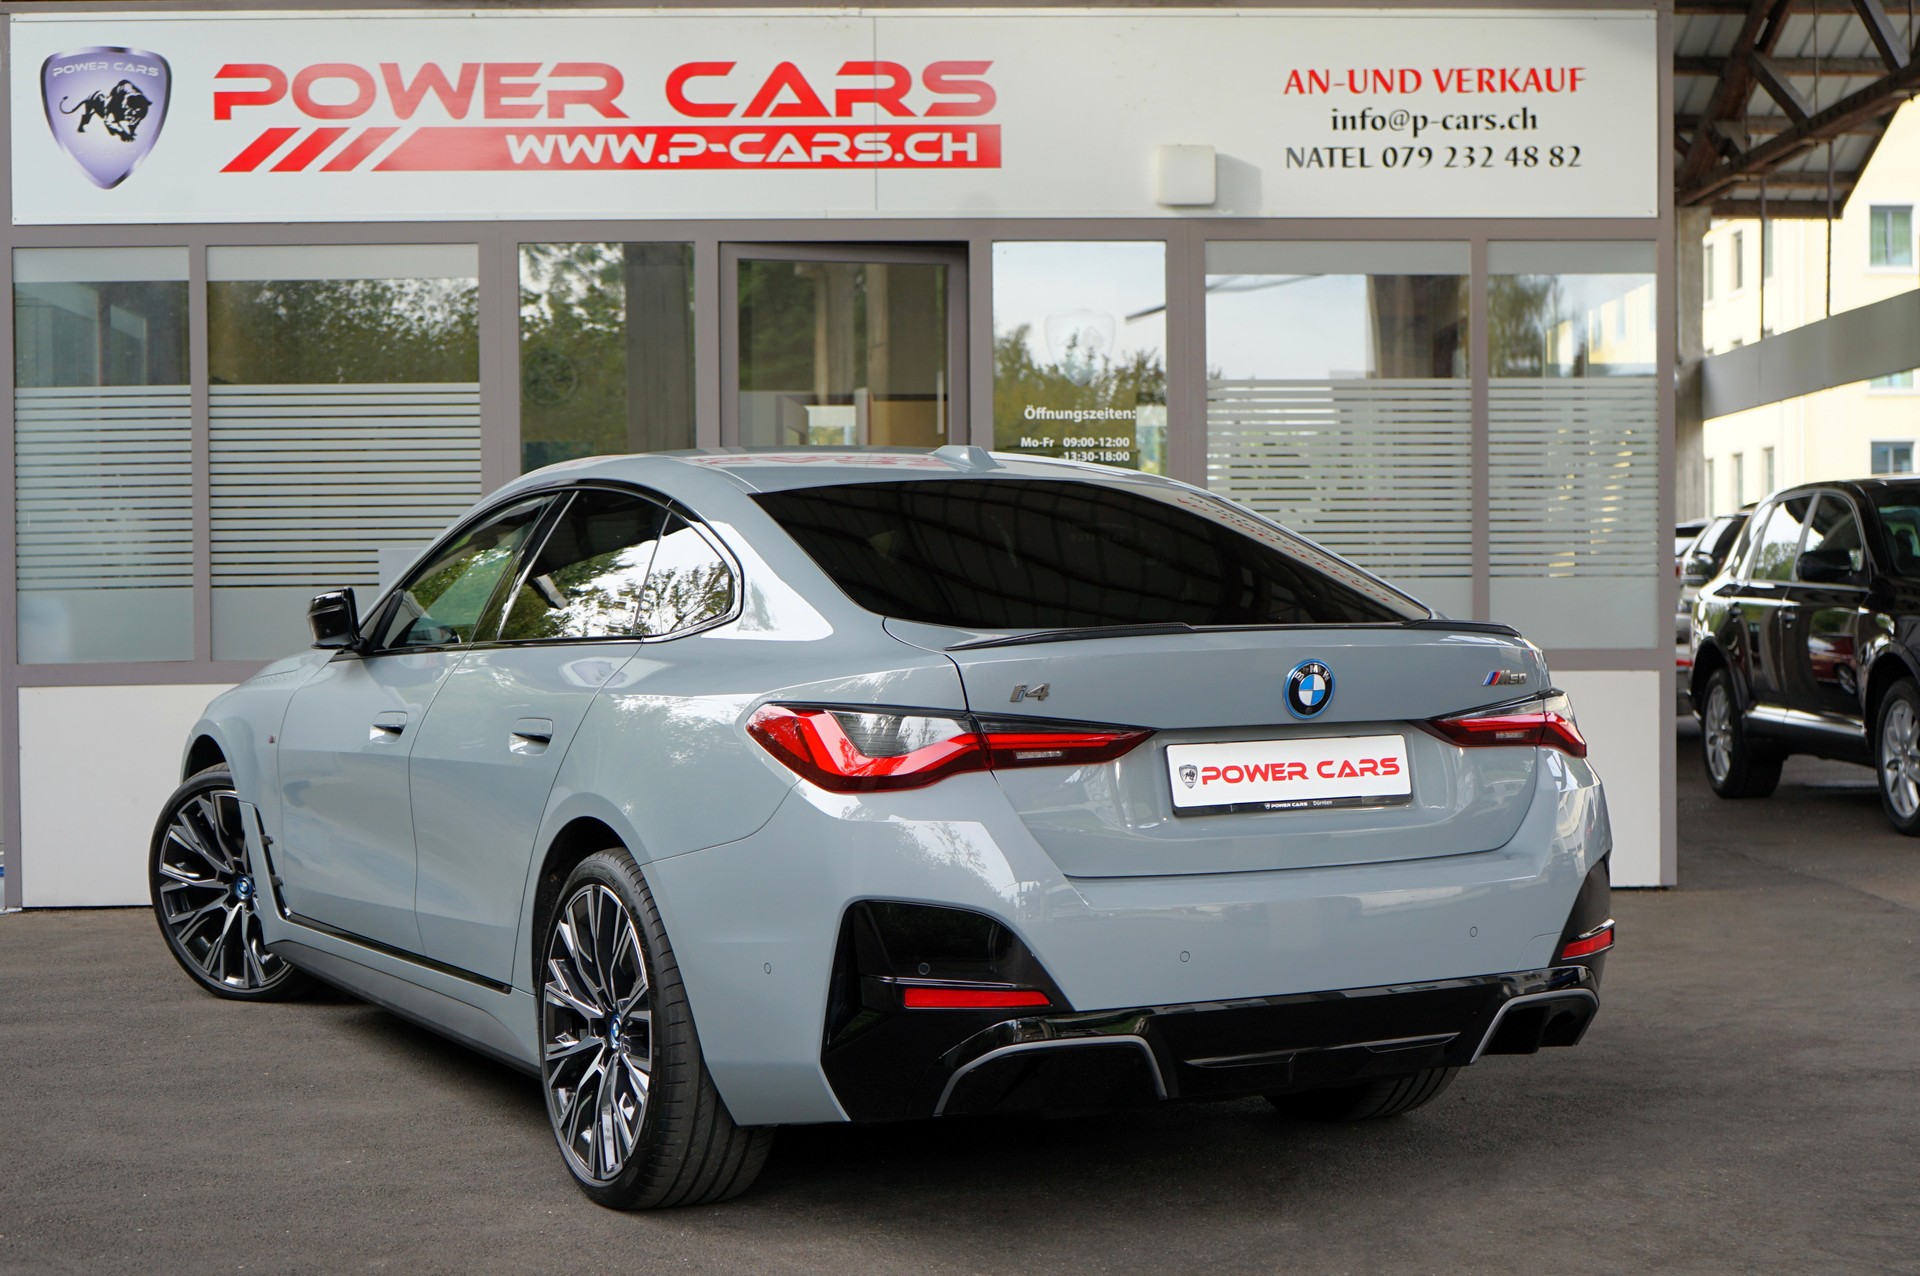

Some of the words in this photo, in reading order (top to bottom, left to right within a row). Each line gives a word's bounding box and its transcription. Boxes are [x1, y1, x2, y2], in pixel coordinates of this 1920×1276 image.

[52, 61, 109, 77] POWER
[113, 61, 160, 77] CARS
[213, 61, 630, 121] POWER
[665, 60, 997, 119] CARS
[1283, 68, 1423, 95] AN-UND
[1431, 66, 1587, 94] VERKAUF
[1330, 106, 1539, 138] info@p-cars.ch
[505, 131, 978, 165] WWW.P-CARS.CH
[1286, 146, 1374, 169] NATEL
[1382, 146, 1434, 168] 079
[1443, 146, 1494, 168] 232
[1504, 145, 1539, 168] 48
[1548, 145, 1583, 168] 82
[1024, 404, 1137, 423] Öffnungszeiten:
[1020, 436, 1055, 448] Mo-Fr
[1062, 436, 1130, 448] 09:00-12:00
[1063, 451, 1130, 462] 13:30-18:00
[1294, 664, 1331, 682] BMW
[1010, 683, 1050, 702] i4
[1201, 762, 1309, 785] POWER
[1316, 757, 1400, 779] CARS
